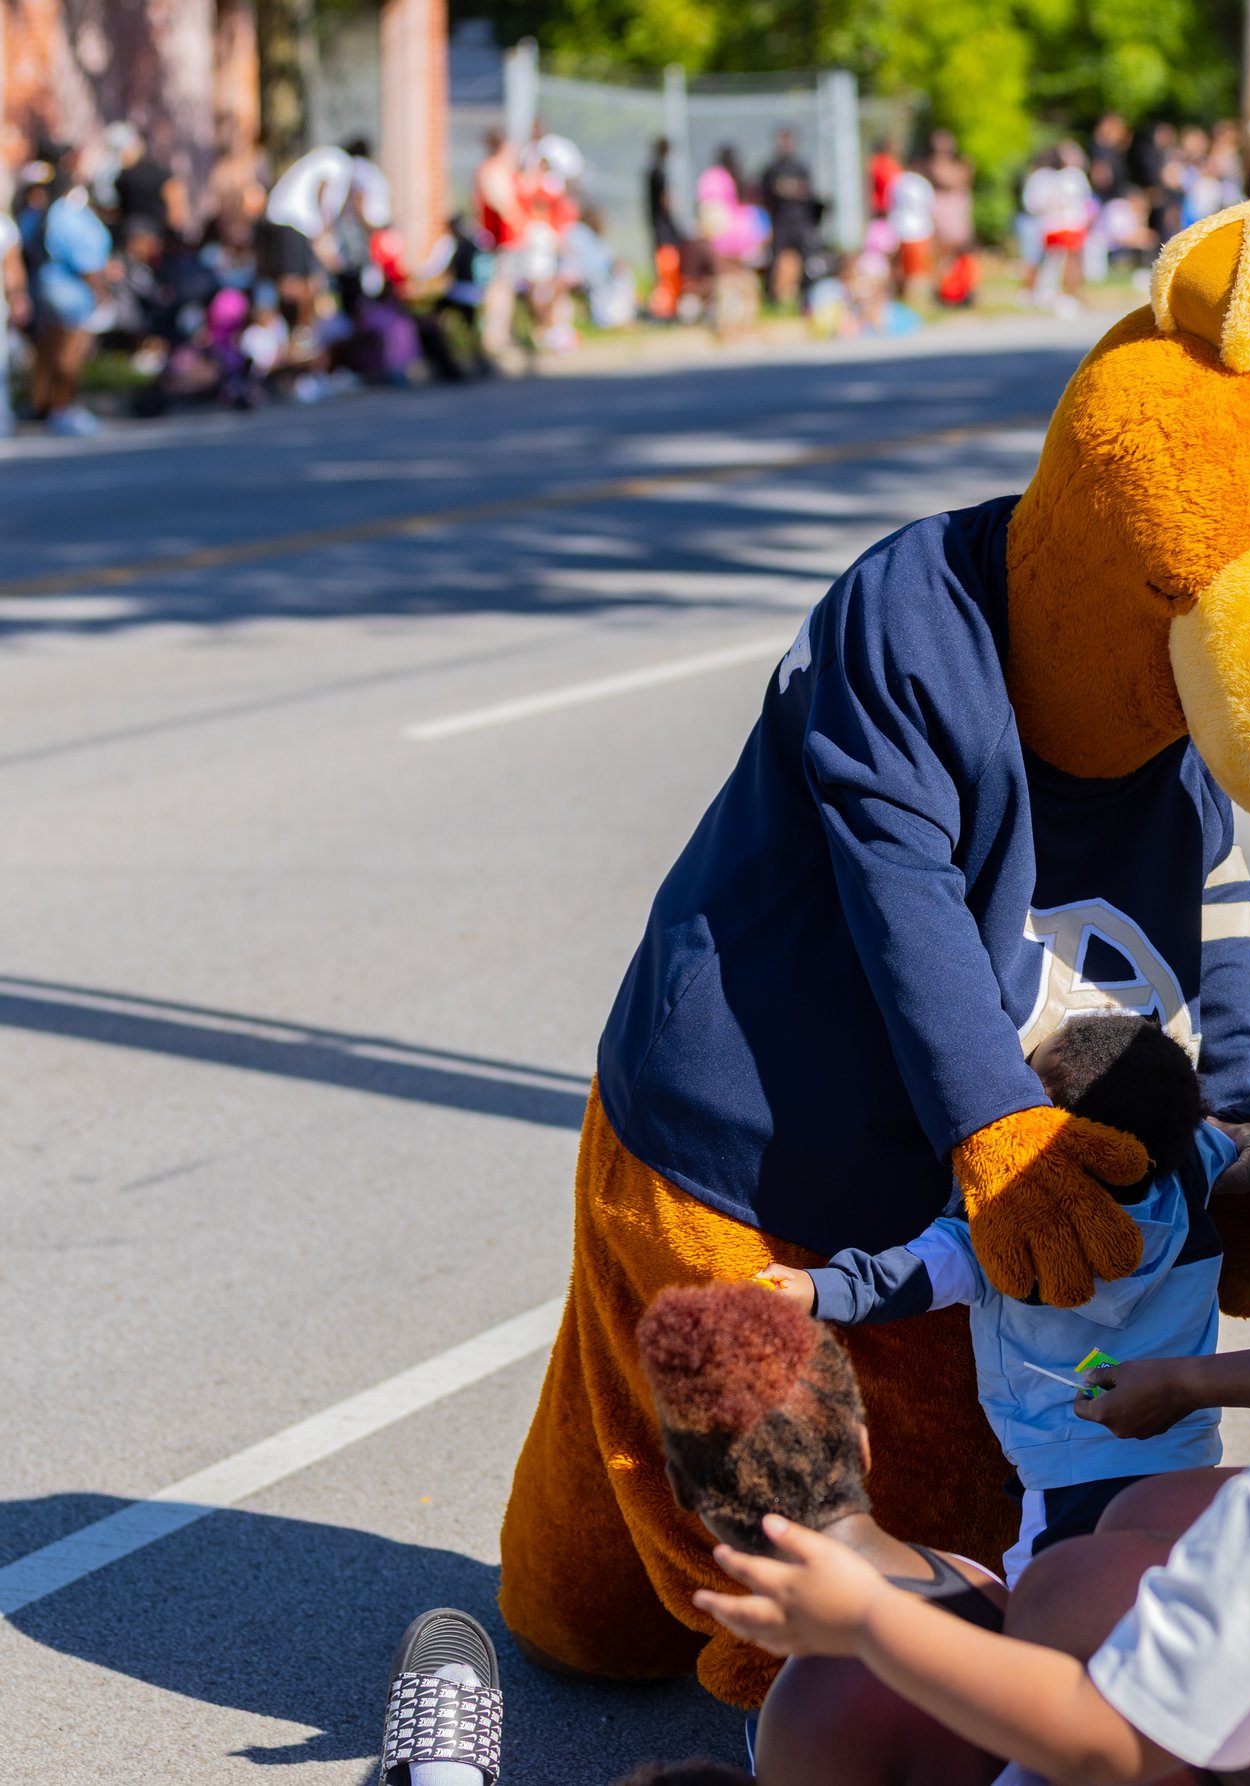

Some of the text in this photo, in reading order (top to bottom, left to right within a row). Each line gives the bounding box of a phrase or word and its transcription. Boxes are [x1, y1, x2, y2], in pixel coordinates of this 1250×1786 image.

[420, 1679, 439, 1687] NIKE
[439, 1688, 458, 1698] NIKE
[419, 1698, 438, 1707] NIKE
[460, 1701, 477, 1712] NIKE
[437, 1708, 456, 1718] NIKE
[417, 1718, 437, 1727] NIKE
[459, 1721, 476, 1732] NIKE
[435, 1728, 455, 1738] NIKE
[416, 1738, 435, 1747] NIKE
[458, 1740, 475, 1751] NIKE
[434, 1748, 454, 1757] NIKE
